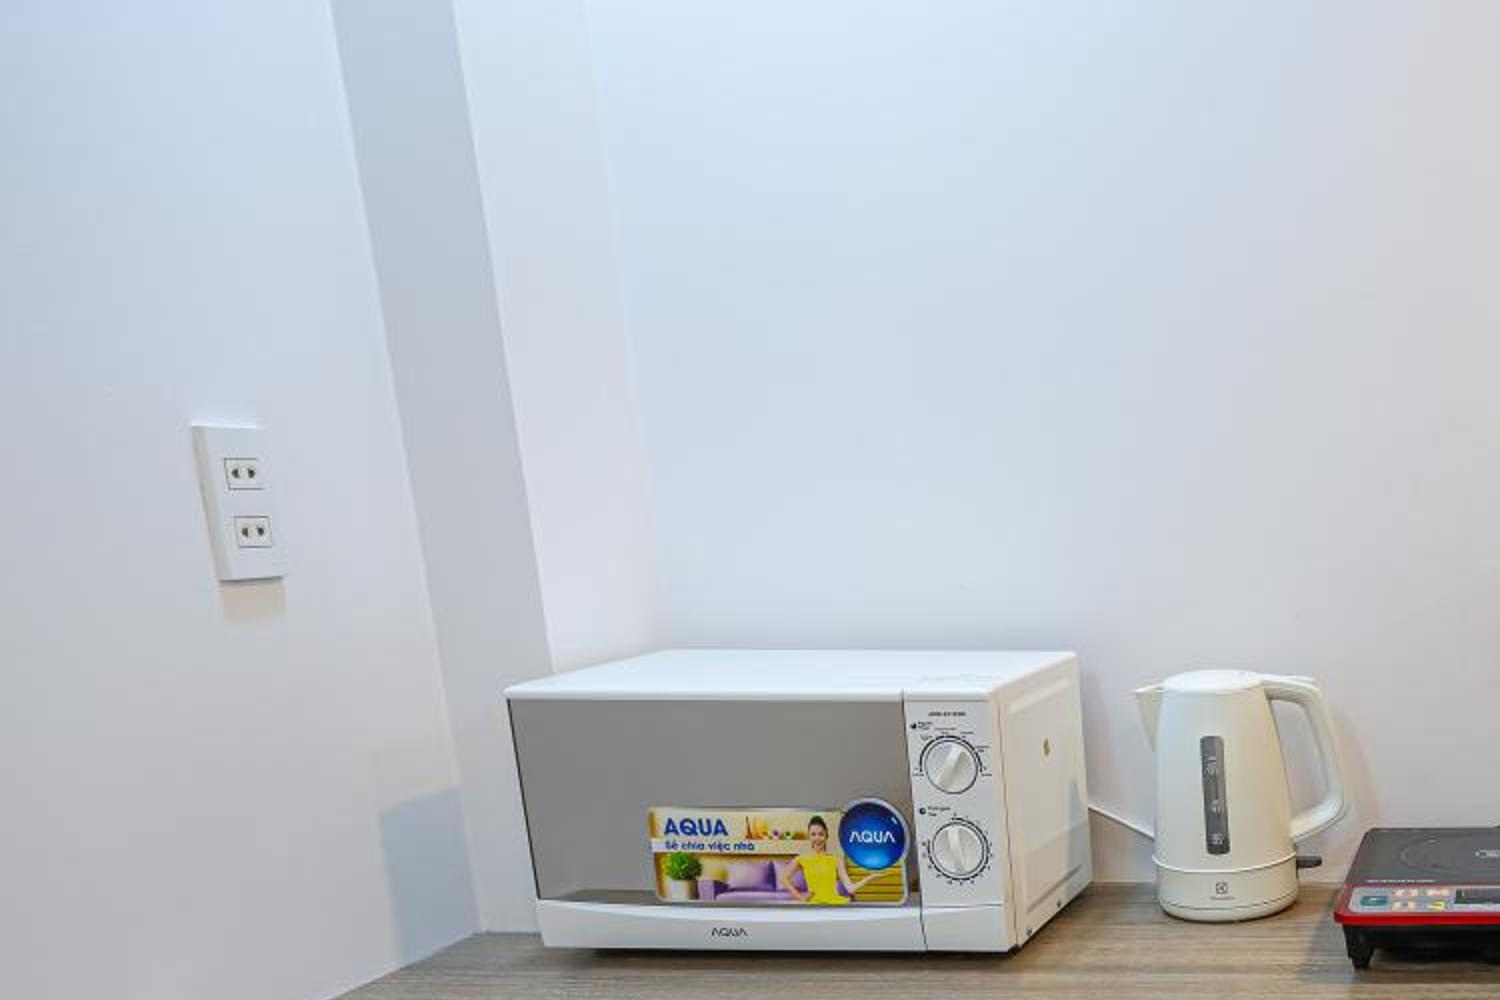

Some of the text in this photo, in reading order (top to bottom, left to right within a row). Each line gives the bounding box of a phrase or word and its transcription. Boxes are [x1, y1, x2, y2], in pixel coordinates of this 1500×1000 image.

[664, 817, 728, 836] AQUA
[849, 830, 896, 843] AQUA
[681, 841, 705, 851] chia
[707, 841, 731, 852] việc
[711, 927, 749, 937] AQUA
